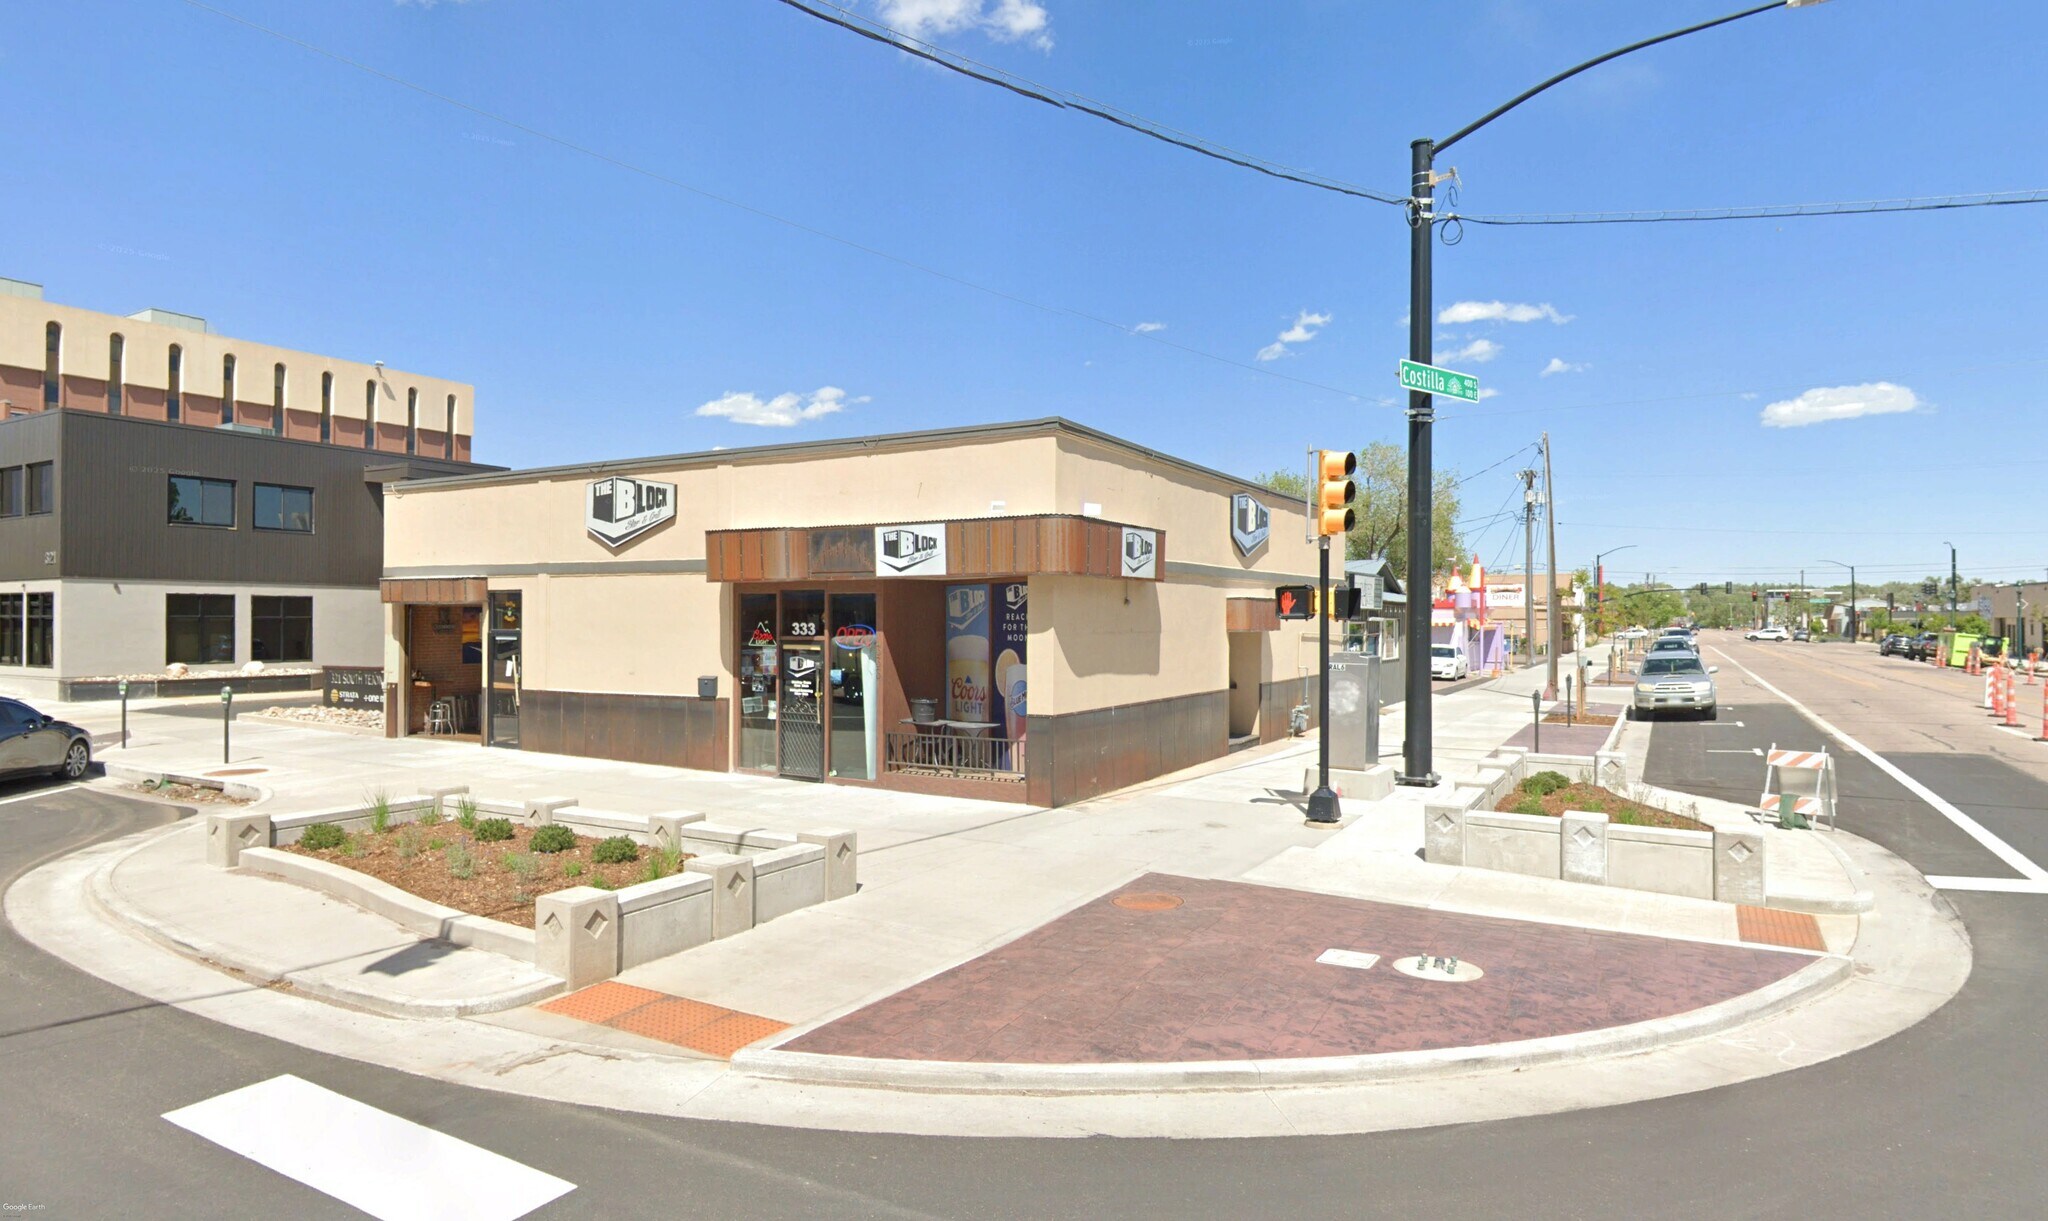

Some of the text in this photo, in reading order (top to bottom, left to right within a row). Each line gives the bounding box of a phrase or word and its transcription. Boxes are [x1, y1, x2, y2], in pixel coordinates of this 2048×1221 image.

[1403, 366, 1444, 391] Costilla
[595, 480, 612, 496] THE
[616, 479, 667, 521] BLOCK
[884, 532, 898, 542] THE
[900, 531, 937, 557] BLOCK
[1006, 613, 1027, 621] REAC
[791, 622, 816, 635] 333
[1003, 623, 1028, 632] FOR TH
[836, 626, 870, 647] OPEN
[342, 673, 363, 685] SOUTH
[339, 691, 359, 699] STRATA
[952, 677, 986, 701] Coors
[955, 701, 983, 714] LIGHT
